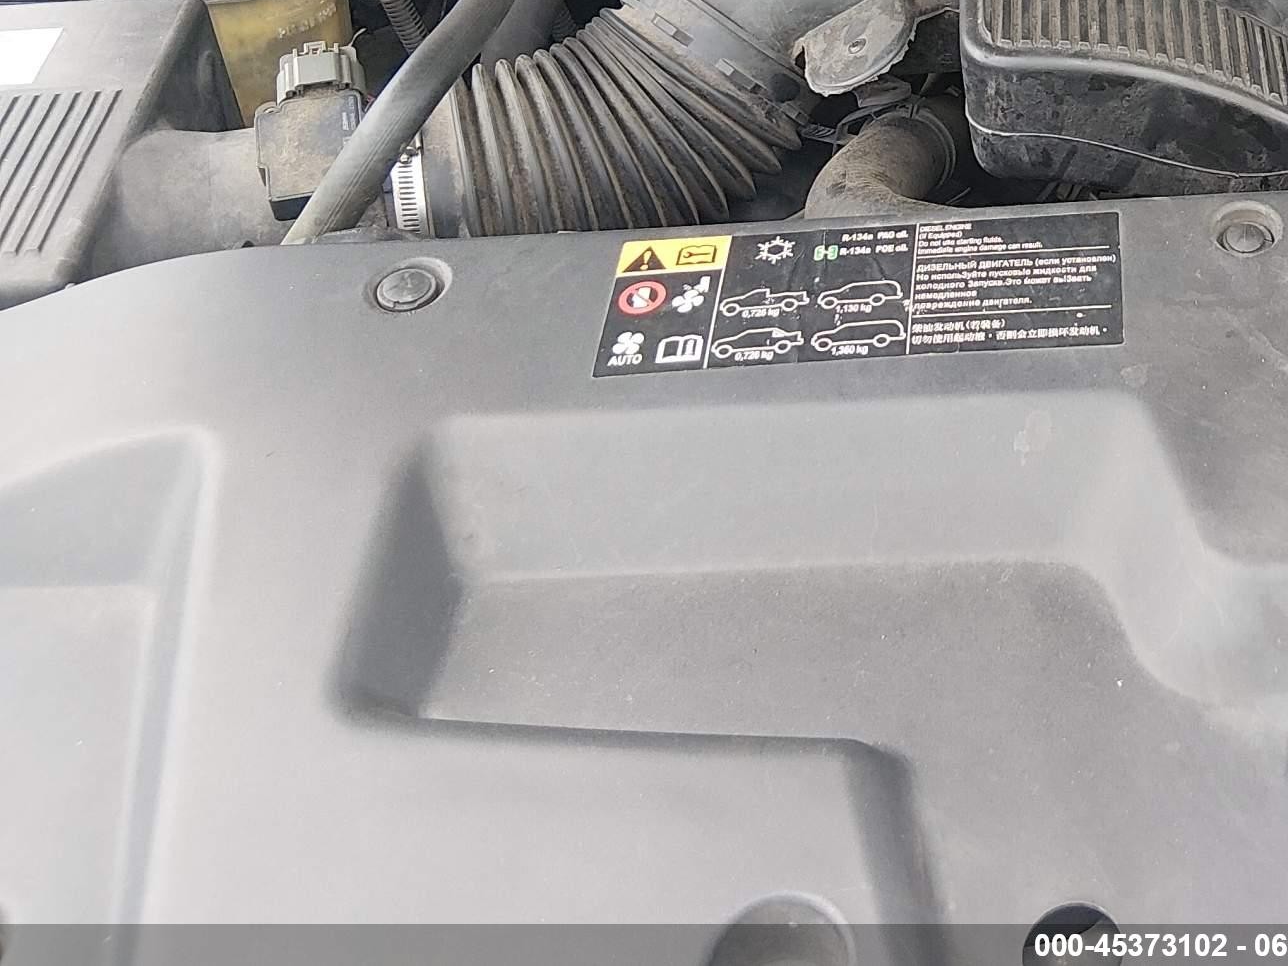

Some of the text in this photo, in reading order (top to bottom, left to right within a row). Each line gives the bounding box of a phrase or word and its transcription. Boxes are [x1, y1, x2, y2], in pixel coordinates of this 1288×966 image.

[956, 237, 982, 245] starting
[875, 244, 895, 253] POE
[954, 244, 978, 253] engine
[979, 242, 1007, 251] damage
[917, 260, 977, 272] ДИЗЕЛЬНЫЙ
[978, 257, 1033, 269] ДВИГАТЕЛЬ
[767, 307, 780, 318] kg
[860, 303, 872, 313] kg
[856, 344, 869, 355] kg
[607, 354, 643, 366] AUTO
[760, 350, 774, 361] kg
